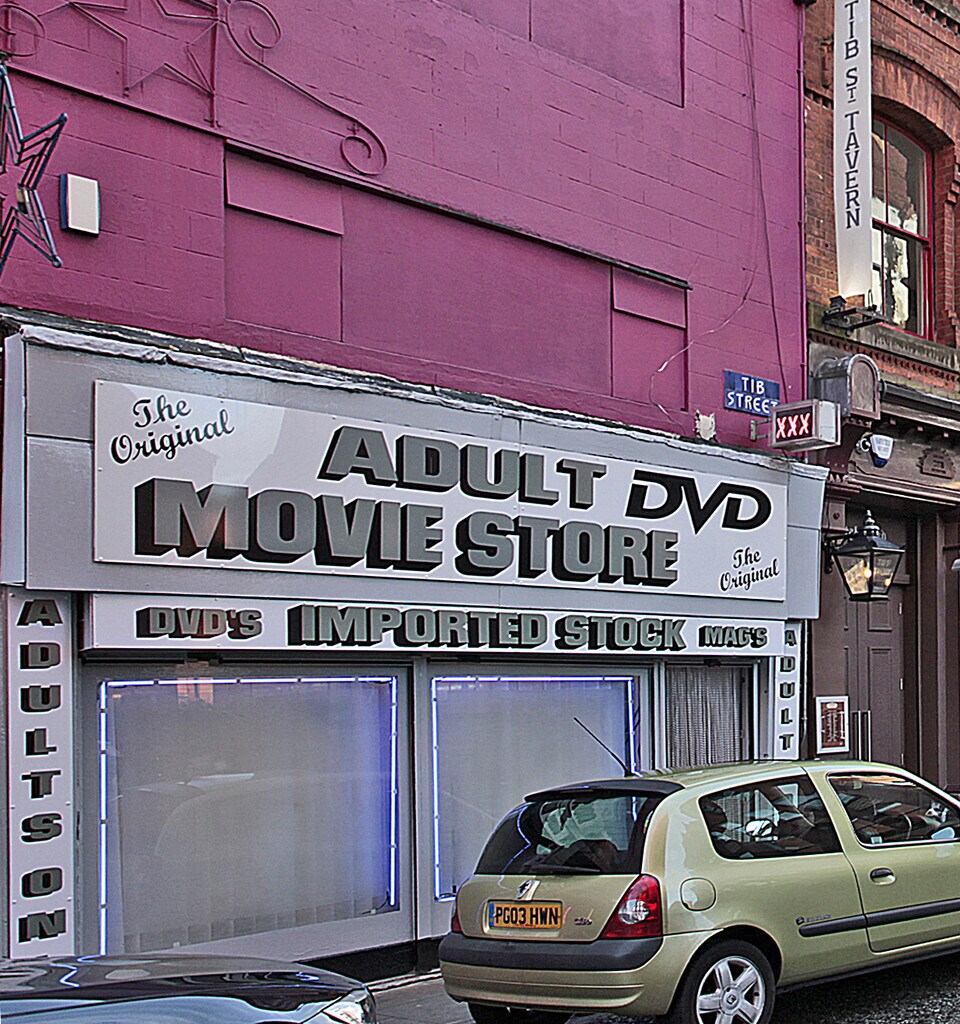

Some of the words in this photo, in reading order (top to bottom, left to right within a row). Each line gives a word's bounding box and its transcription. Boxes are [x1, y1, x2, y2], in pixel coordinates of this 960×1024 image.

[844, 0, 859, 59] TIB
[845, 111, 860, 229] TAVERN
[741, 376, 765, 395] TIB
[132, 395, 191, 428] The
[776, 413, 811, 439] XXX
[111, 410, 234, 464] Original
[318, 425, 606, 510] ADULT
[625, 469, 772, 535] DVD
[134, 478, 443, 572] MOVIE
[455, 511, 678, 588] STORE
[720, 558, 779, 591] Original
[733, 547, 761, 569] The
[136, 607, 262, 639] DVD'S
[287, 604, 547, 648] IMPORTED
[555, 614, 686, 650] STOCK
[699, 625, 768, 649] MAG'S
[779, 629, 797, 750] ADULT
[495, 906, 527, 924] PG03
[530, 907, 559, 925] HWN
